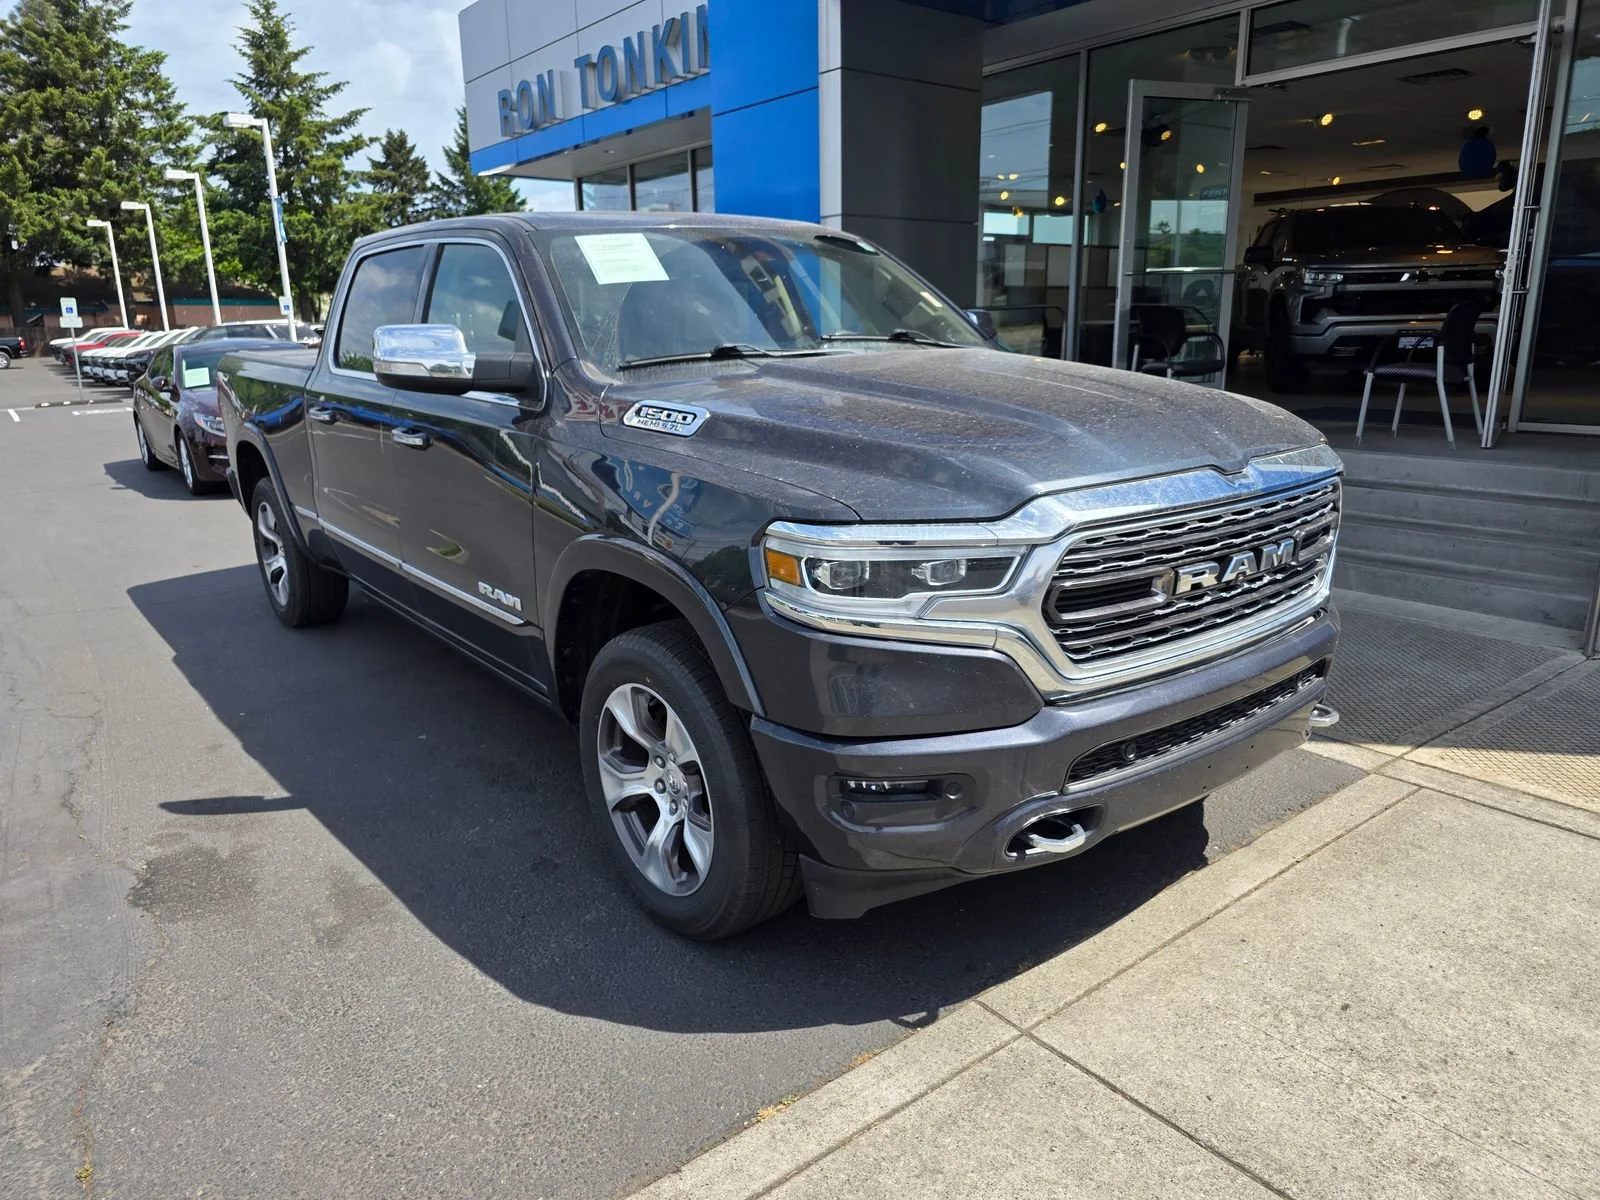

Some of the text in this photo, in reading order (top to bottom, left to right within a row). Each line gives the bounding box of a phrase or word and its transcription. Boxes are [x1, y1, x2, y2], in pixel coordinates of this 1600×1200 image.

[497, 69, 556, 137] RON
[637, 419, 680, 432] HEMI 5.7L
[640, 407, 695, 424] 1500
[1176, 538, 1294, 594] RAM
[478, 581, 521, 611] RAM
